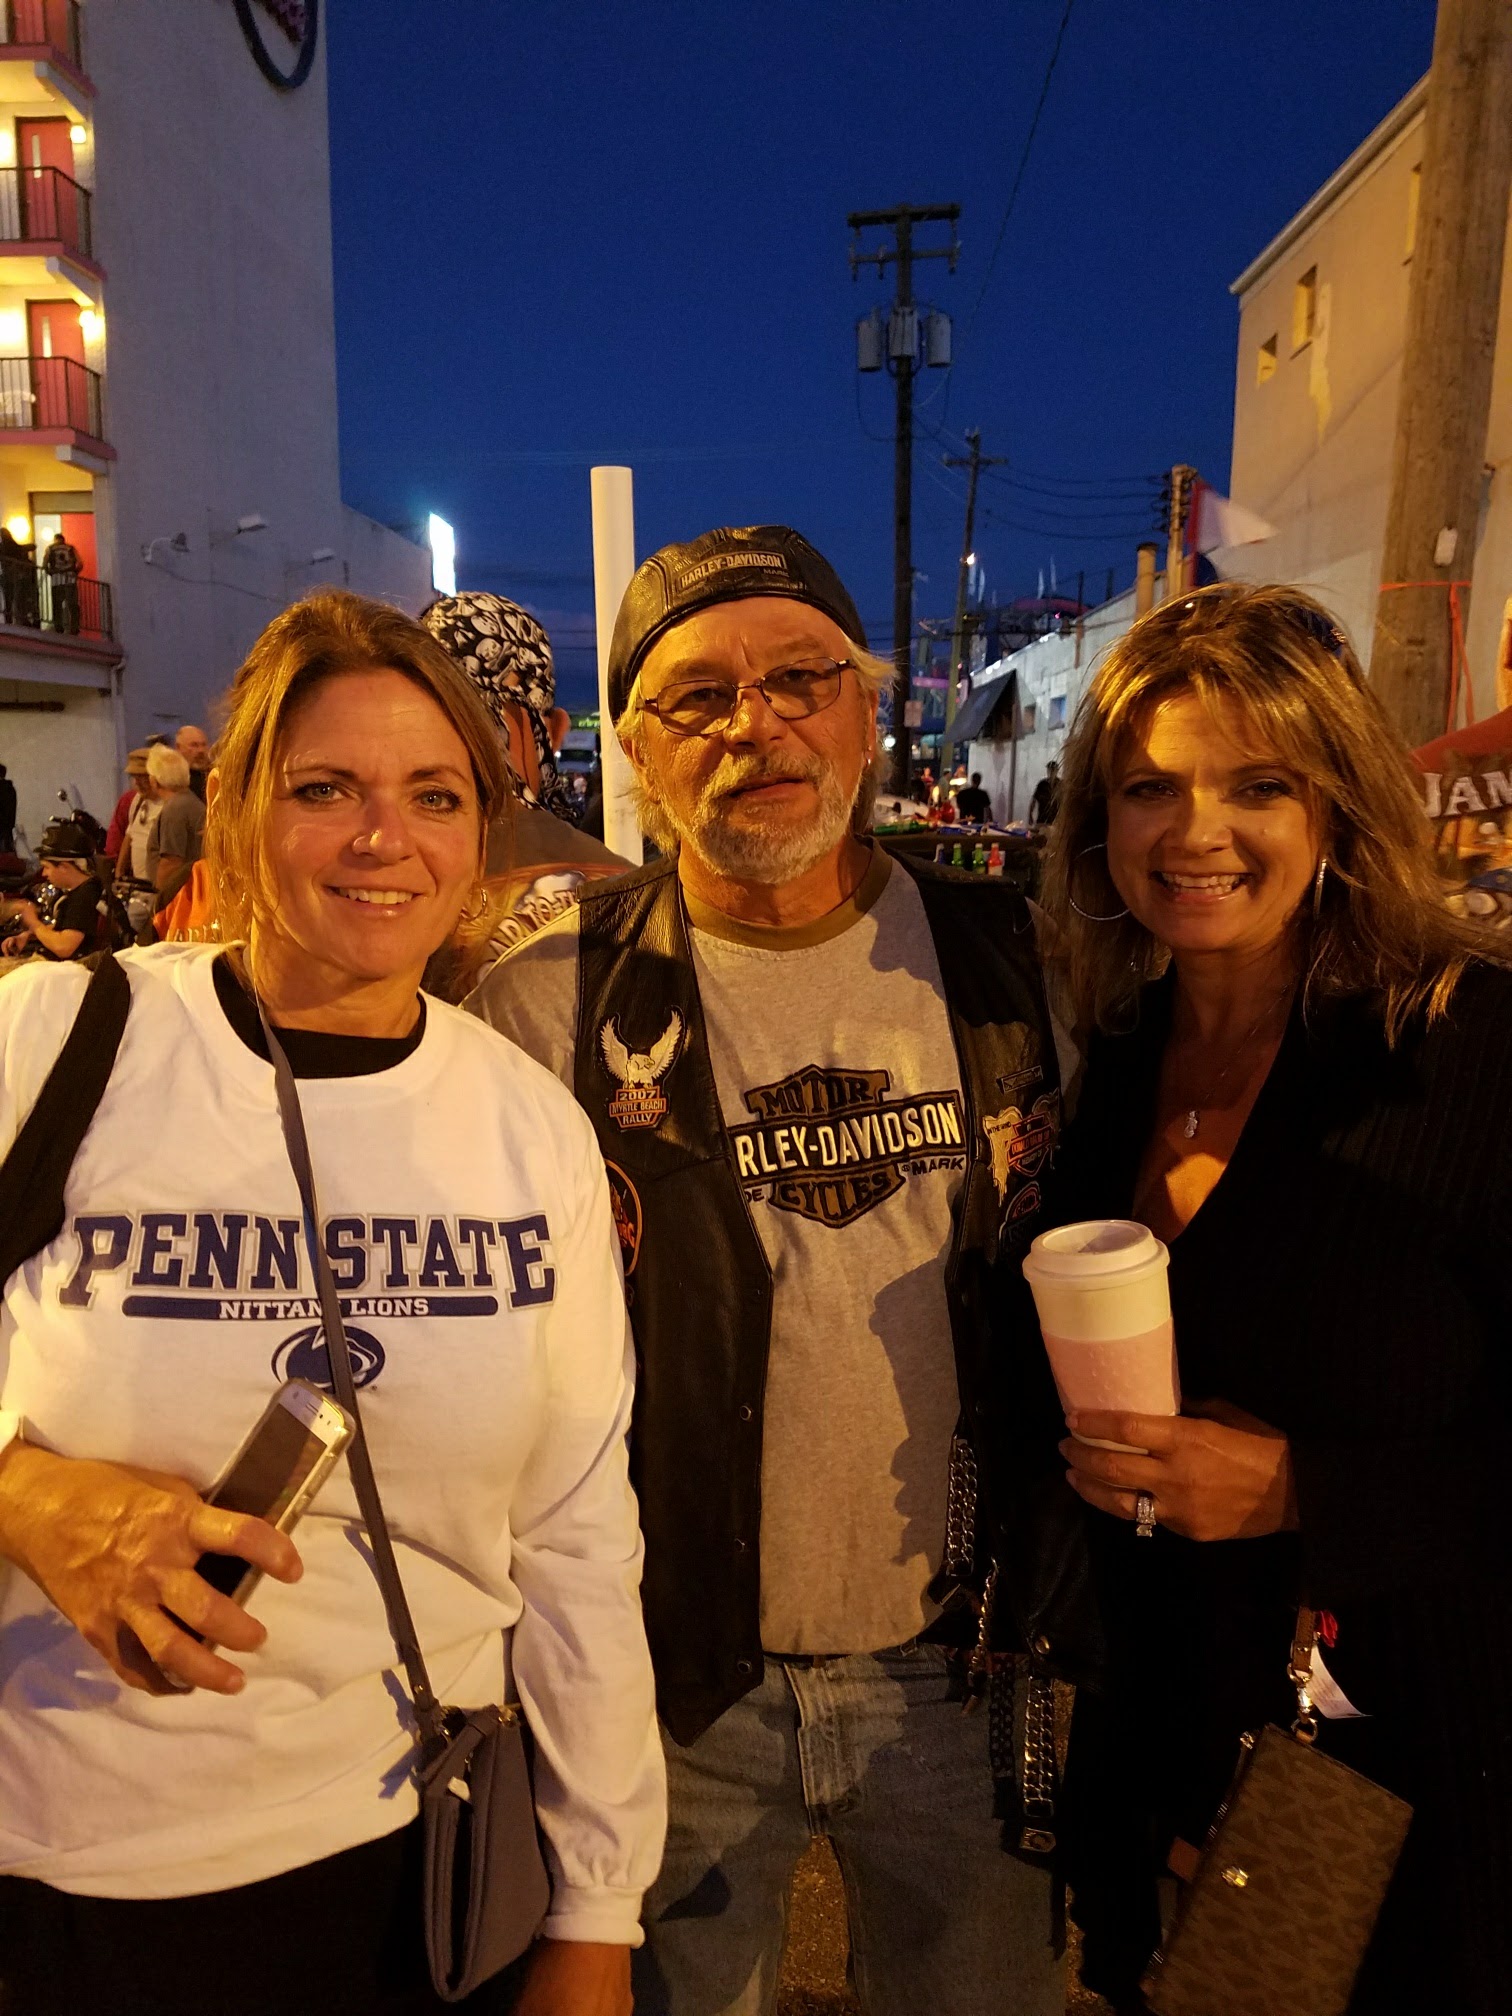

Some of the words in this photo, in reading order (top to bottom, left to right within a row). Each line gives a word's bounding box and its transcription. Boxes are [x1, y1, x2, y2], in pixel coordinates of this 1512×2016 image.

[681, 553, 782, 588] HARLEY-DAVIDSON
[620, 1090, 656, 1101] 2007
[761, 1071, 875, 1117] MOTOR
[612, 1103, 638, 1114] MYRTLE
[640, 1100, 663, 1111] BEACH
[622, 1113, 653, 1125] RALLY
[911, 1157, 965, 1176] MARK
[780, 1172, 893, 1220] CYCLES
[58, 1211, 301, 1309] PENN
[323, 1212, 558, 1311] STATE
[219, 1300, 341, 1319] NITTAN
[350, 1298, 429, 1317] LIONS
